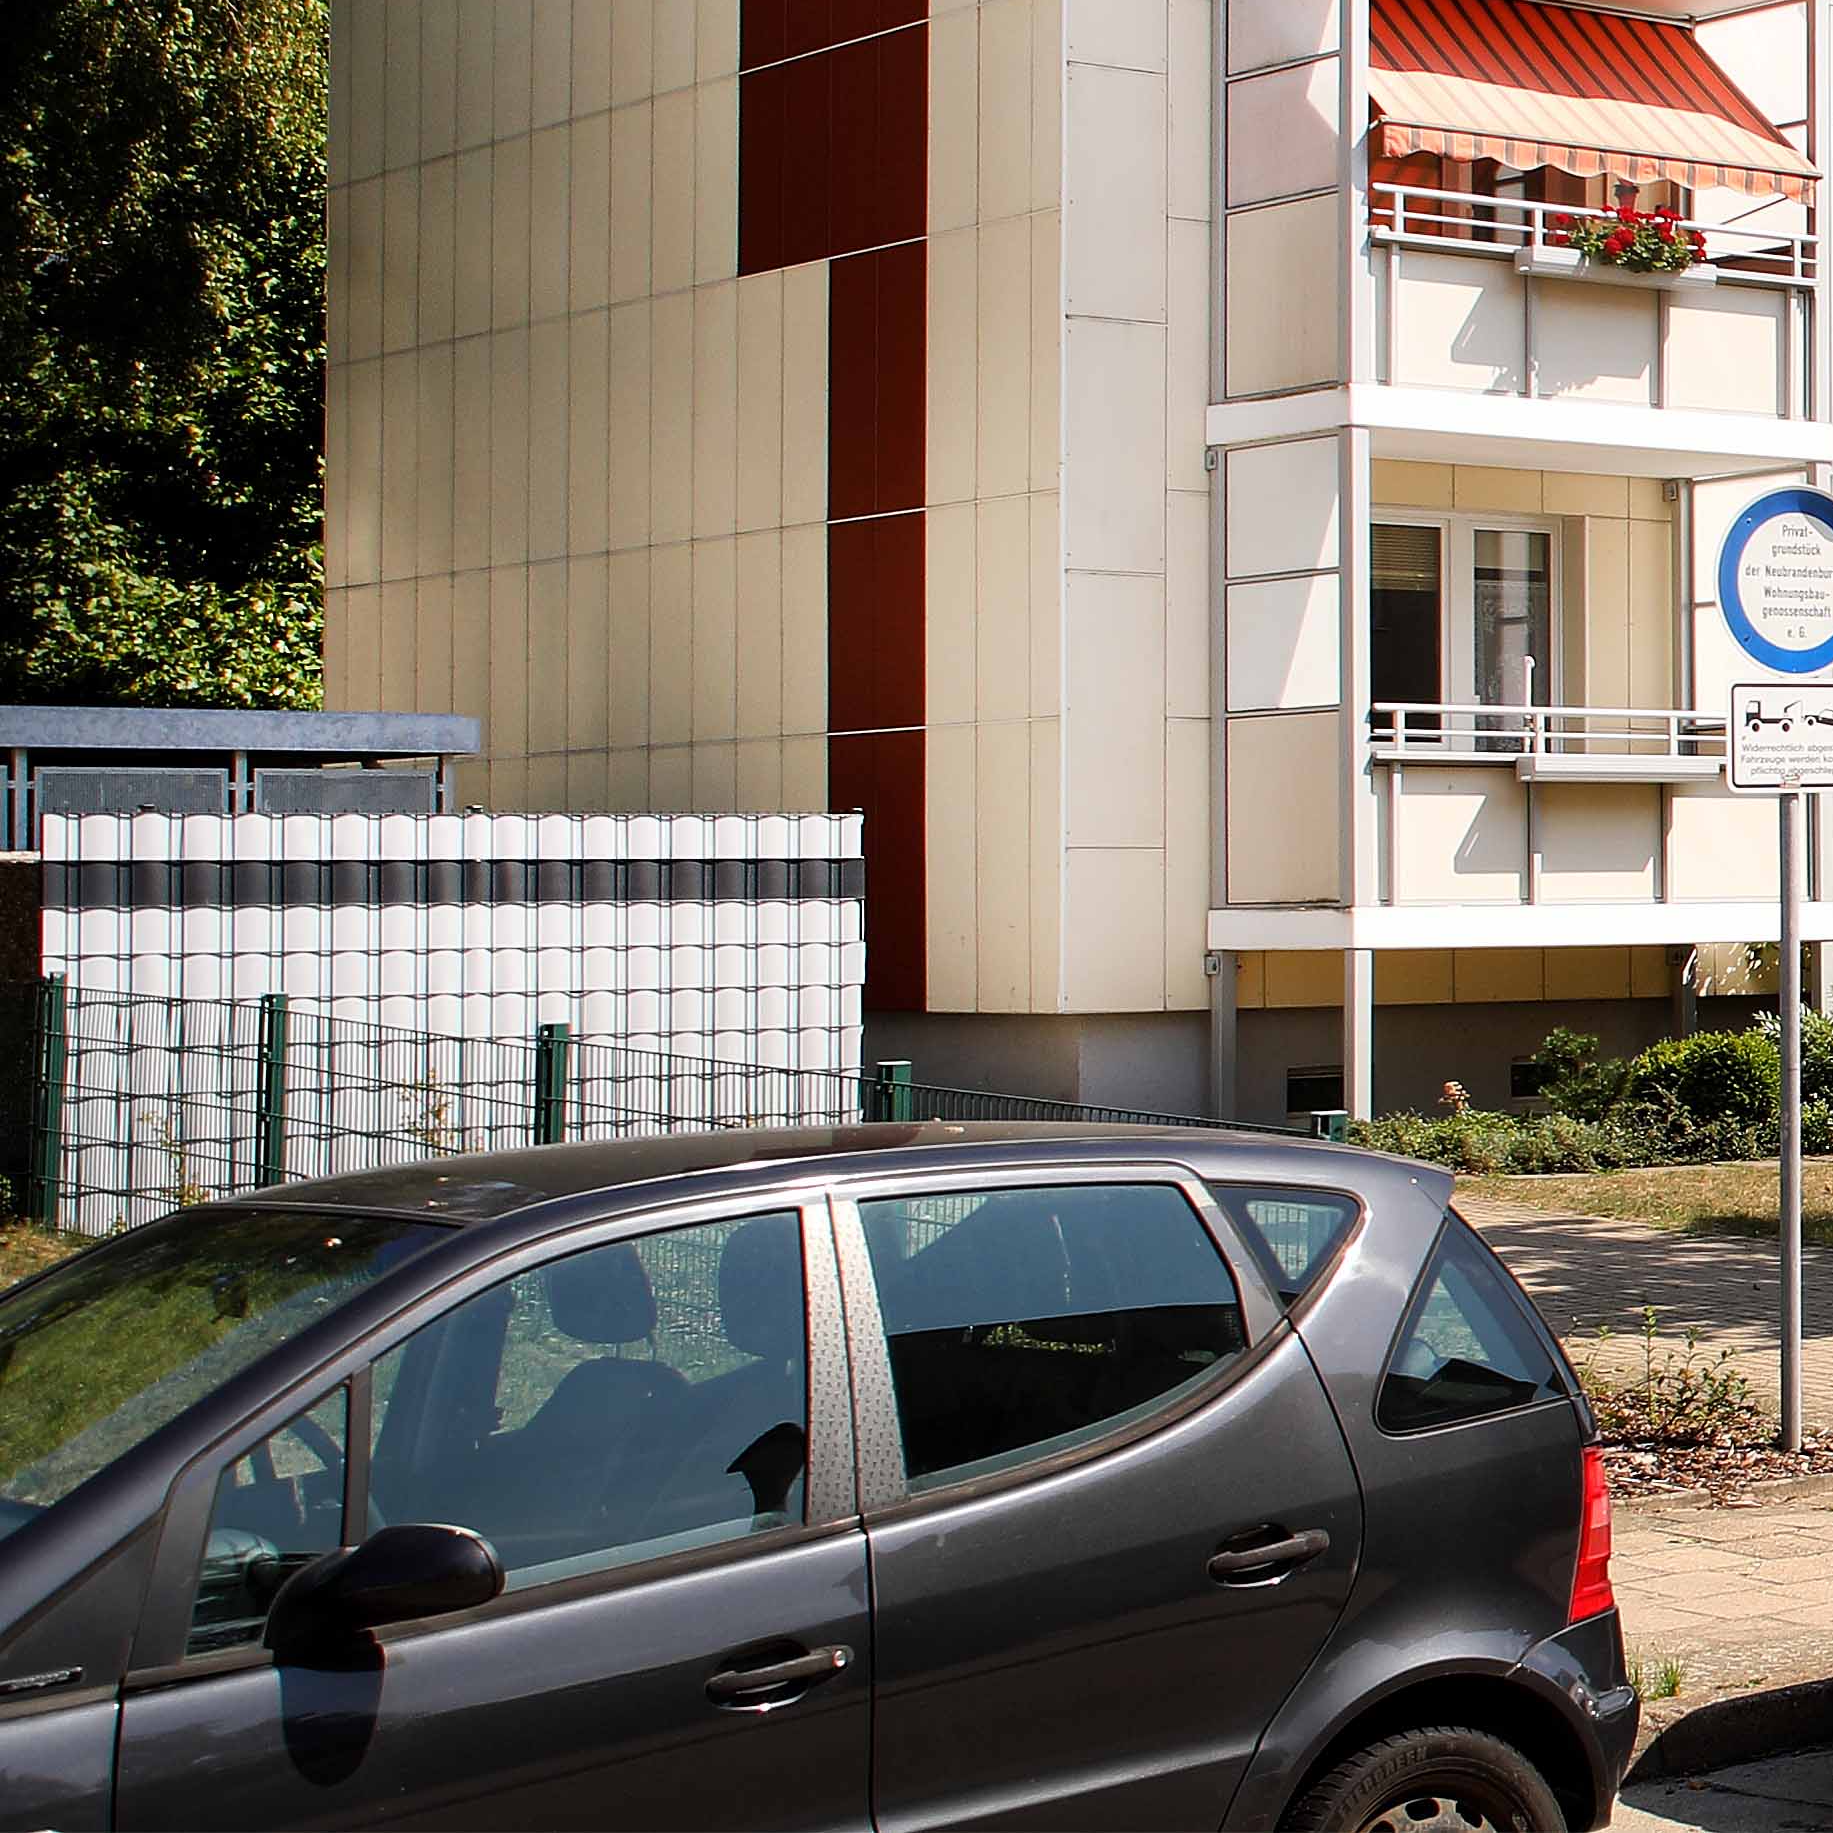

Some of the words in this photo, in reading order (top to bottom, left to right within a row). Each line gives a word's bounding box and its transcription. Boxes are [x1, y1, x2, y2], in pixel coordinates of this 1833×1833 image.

[1782, 525, 1813, 537] Privat-
[1771, 544, 1821, 557] grundstück
[1745, 565, 1760, 576] der
[1764, 586, 1830, 601] Wohnungsbau-
[1762, 606, 1831, 619] genossenschaft
[1742, 744, 1804, 752] Widerrechtlich
[1741, 755, 1786, 764] Fahrzeuge
